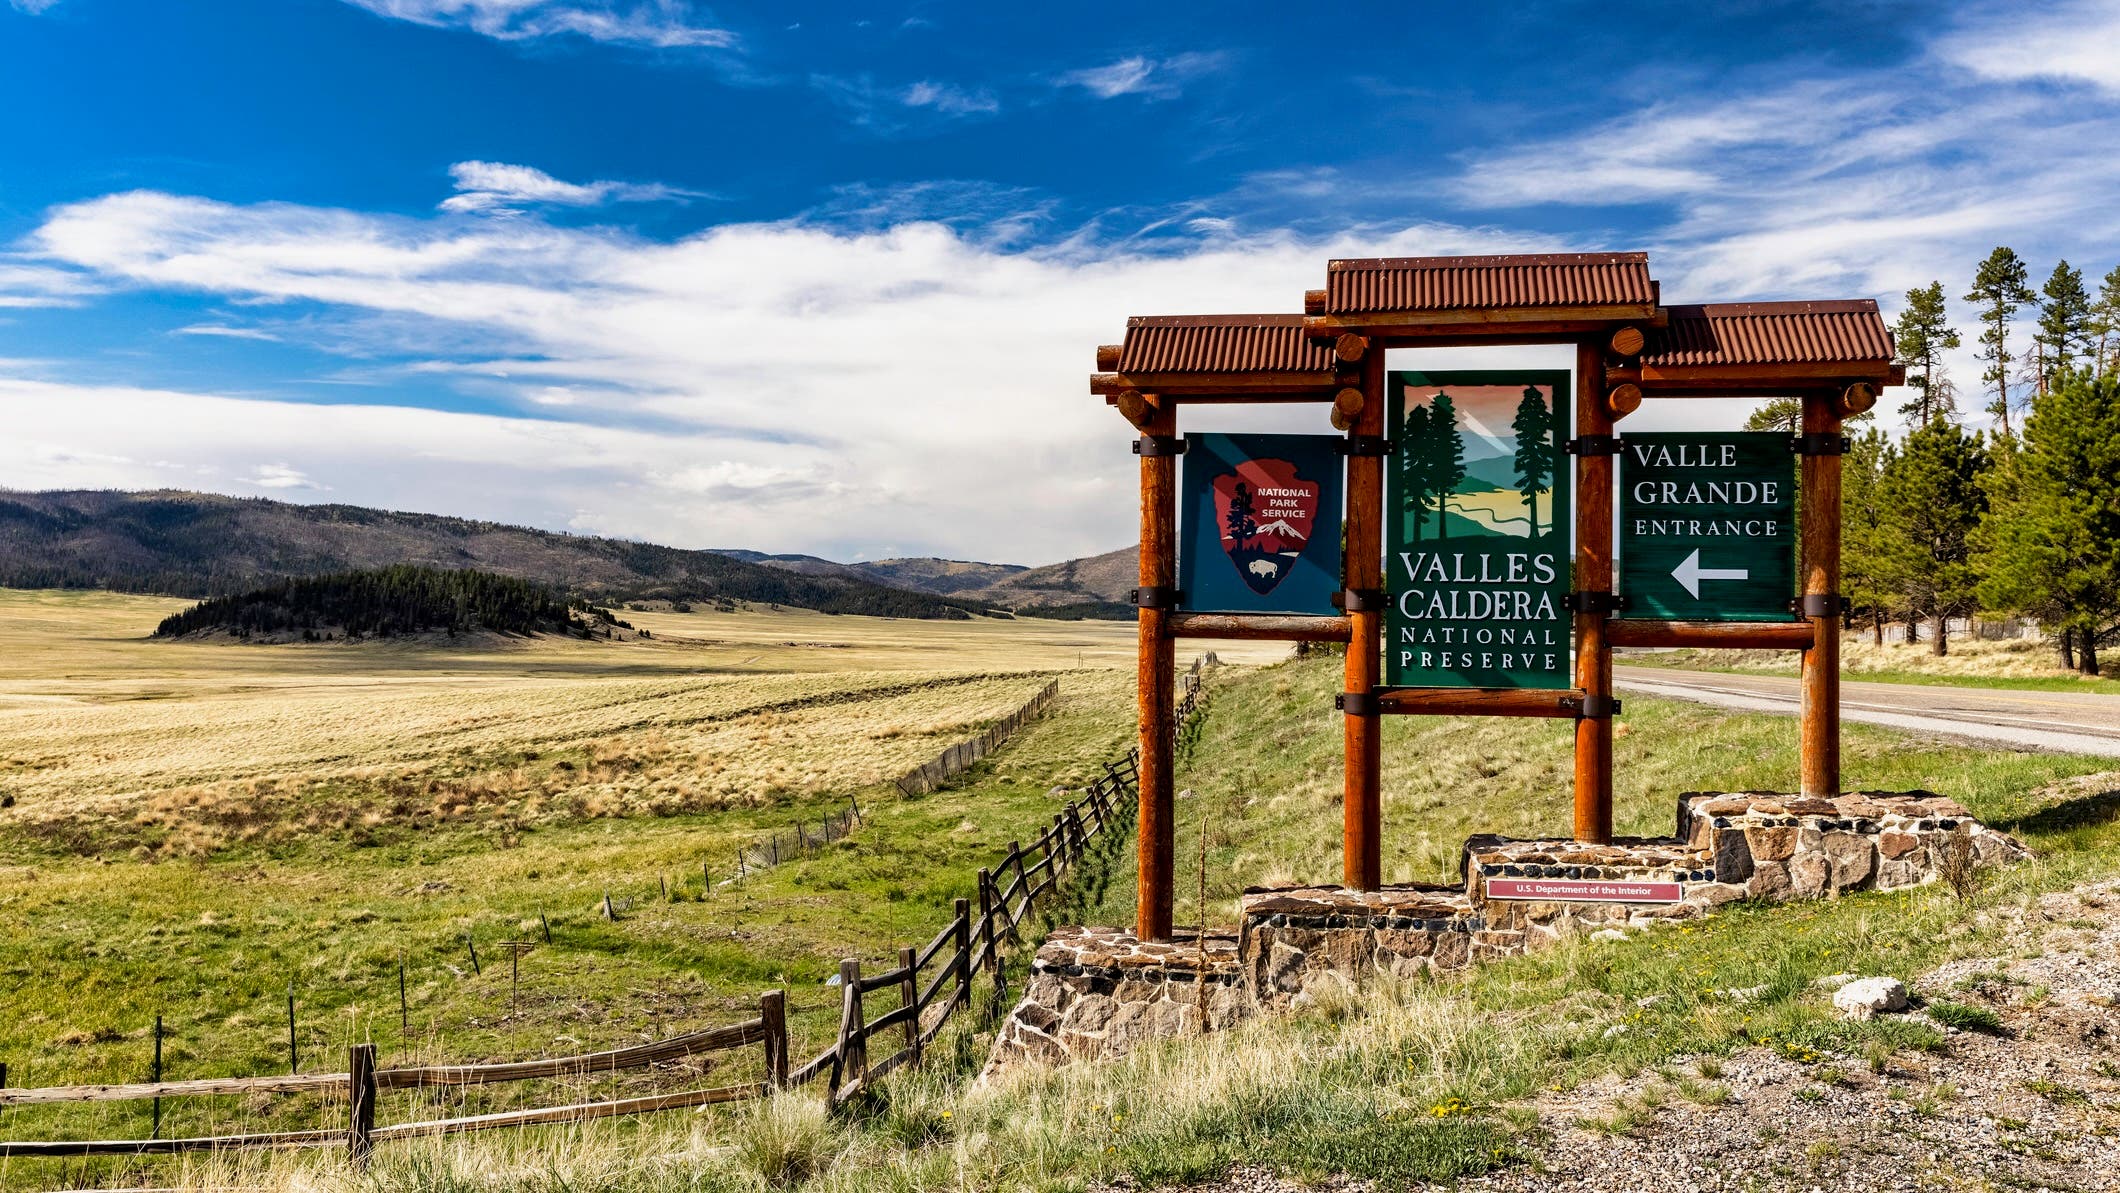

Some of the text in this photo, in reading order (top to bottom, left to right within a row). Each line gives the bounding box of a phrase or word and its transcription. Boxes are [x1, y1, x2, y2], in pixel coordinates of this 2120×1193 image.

[1633, 445, 1737, 467] VALLE
[1258, 488, 1311, 497] NATIONAL
[1634, 481, 1778, 504] GRANDE
[1270, 499, 1298, 507] PARK
[1262, 509, 1306, 518] SERVICE
[1635, 519, 1777, 536] ENTRANCE
[1399, 552, 1556, 584] VALLES
[1400, 589, 1557, 620] CALDERA
[1401, 627, 1556, 645] NATIONAL
[1401, 651, 1556, 670] PRESERVE
[1516, 884, 1652, 895] U.S. Department of the Interior
